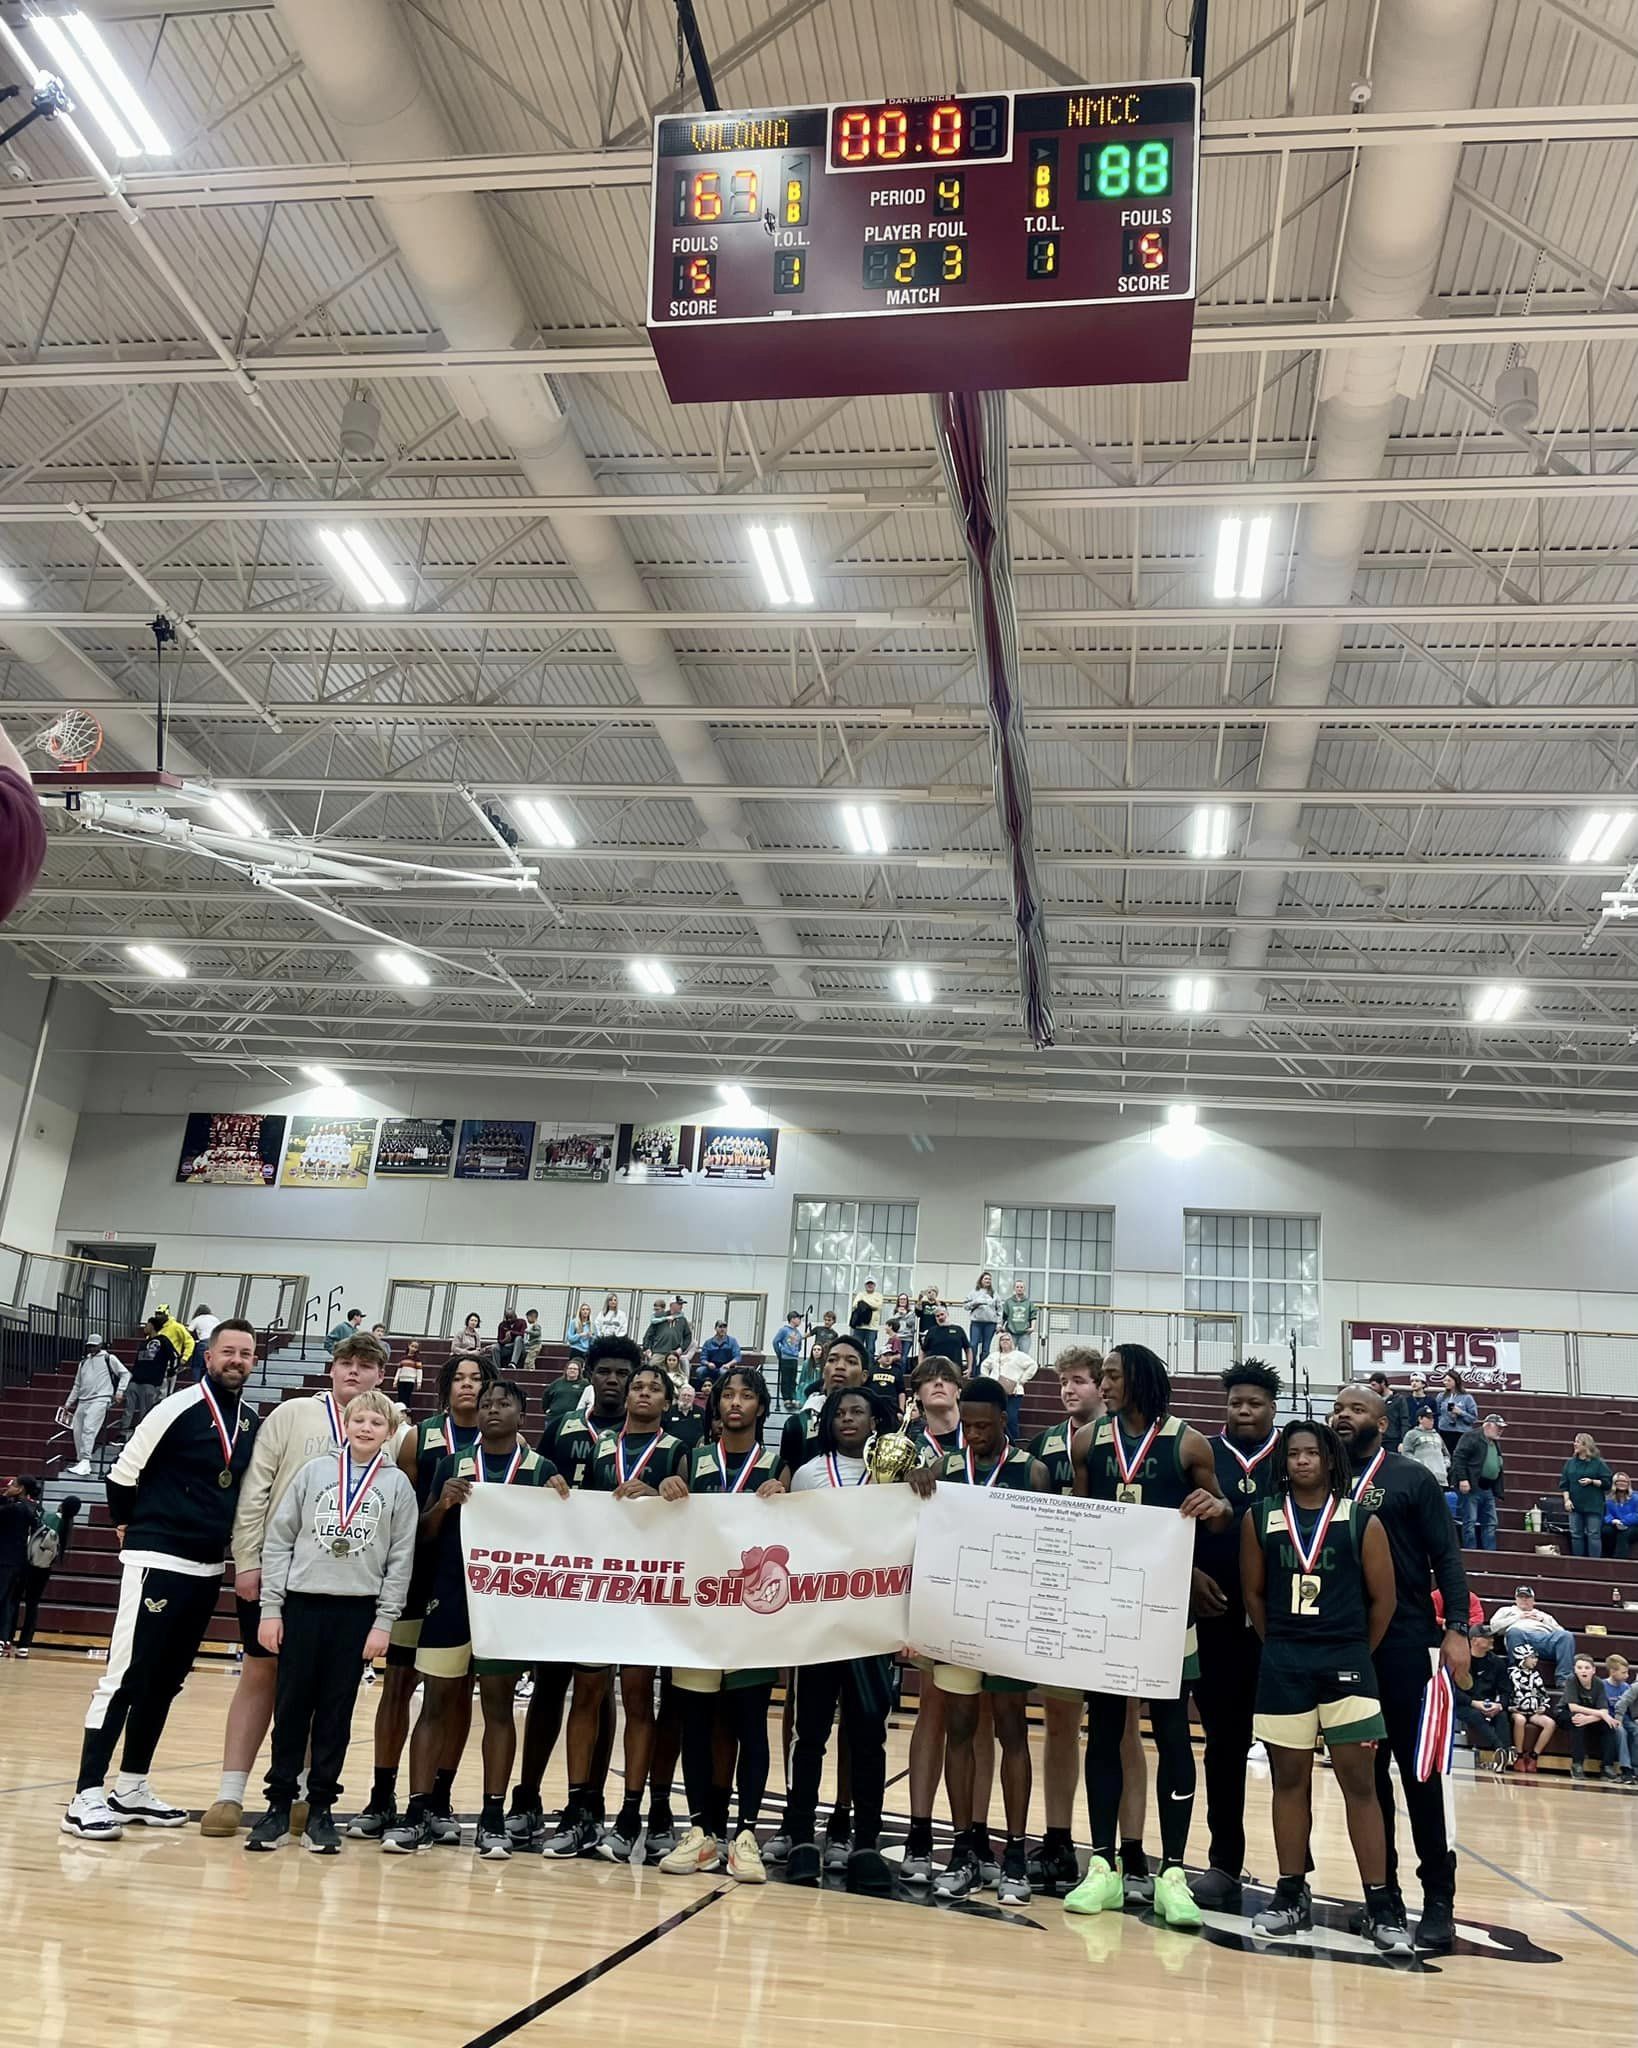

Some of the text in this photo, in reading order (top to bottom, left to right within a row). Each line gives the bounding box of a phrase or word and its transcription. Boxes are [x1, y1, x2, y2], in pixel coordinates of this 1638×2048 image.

[1068, 94, 1140, 127] NMCC
[690, 119, 789, 151] VILONIA
[841, 107, 961, 161] 00.0
[1098, 142, 1168, 197] 88
[694, 170, 758, 221] 67
[870, 188, 926, 207] PERIOD
[938, 180, 960, 209] 4
[1024, 215, 1065, 232] T.O.L.
[1121, 208, 1172, 226] FOULS
[672, 236, 719, 253] FOULS
[772, 231, 811, 247] T.O.L.
[864, 221, 968, 242] PLAYER FOUL
[895, 244, 962, 283] 2 3
[1141, 232, 1163, 269] 5
[690, 258, 711, 295] 5
[1118, 275, 1170, 292] SCORE
[670, 299, 717, 317] SCORE
[886, 287, 940, 305] MATCH
[1369, 1328, 1498, 1368] PBHS
[1005, 1493, 1048, 1504] SHOWDOWN
[1049, 1498, 1096, 1511] TOURNAMENT
[1096, 1503, 1127, 1514] BRACKET
[470, 1548, 686, 1574] POPLAR BLUFF
[467, 1562, 691, 1606] BASKETBALL
